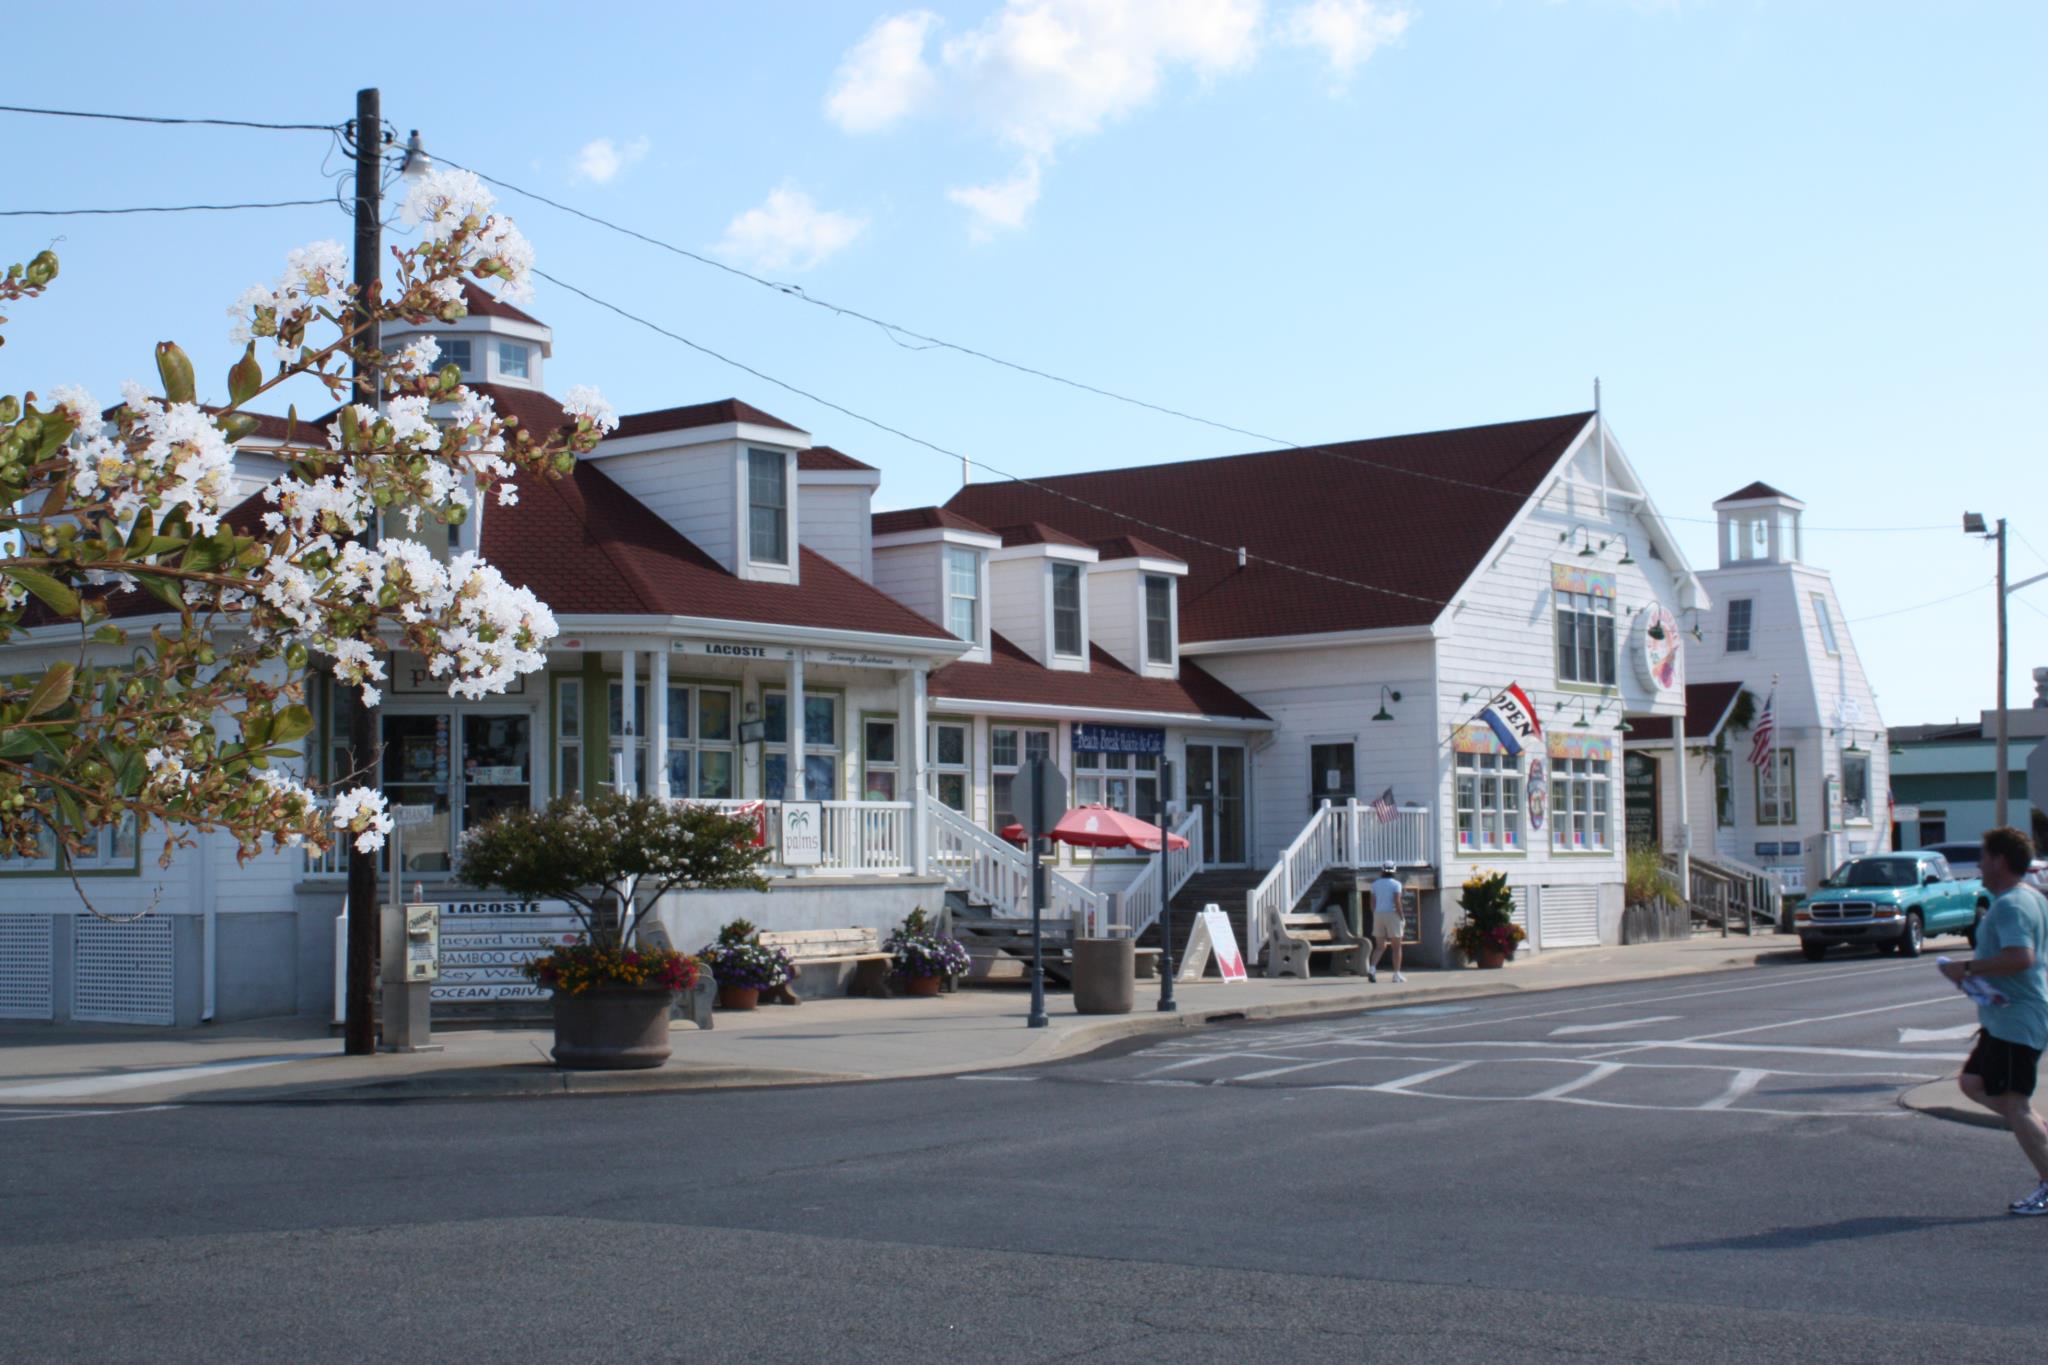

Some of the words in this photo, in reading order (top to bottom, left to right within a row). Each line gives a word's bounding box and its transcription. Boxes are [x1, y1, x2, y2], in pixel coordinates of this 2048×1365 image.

[705, 643, 766, 657] LACOSTE
[1493, 695, 1534, 737] OPEN
[785, 834, 819, 855] palms
[448, 903, 541, 913] LACOSTE
[441, 935, 503, 947] neyard
[440, 952, 505, 964] BAMBOO
[509, 951, 538, 964] CAY
[430, 988, 490, 998] OCEAN
[500, 987, 545, 996] DRIVE
